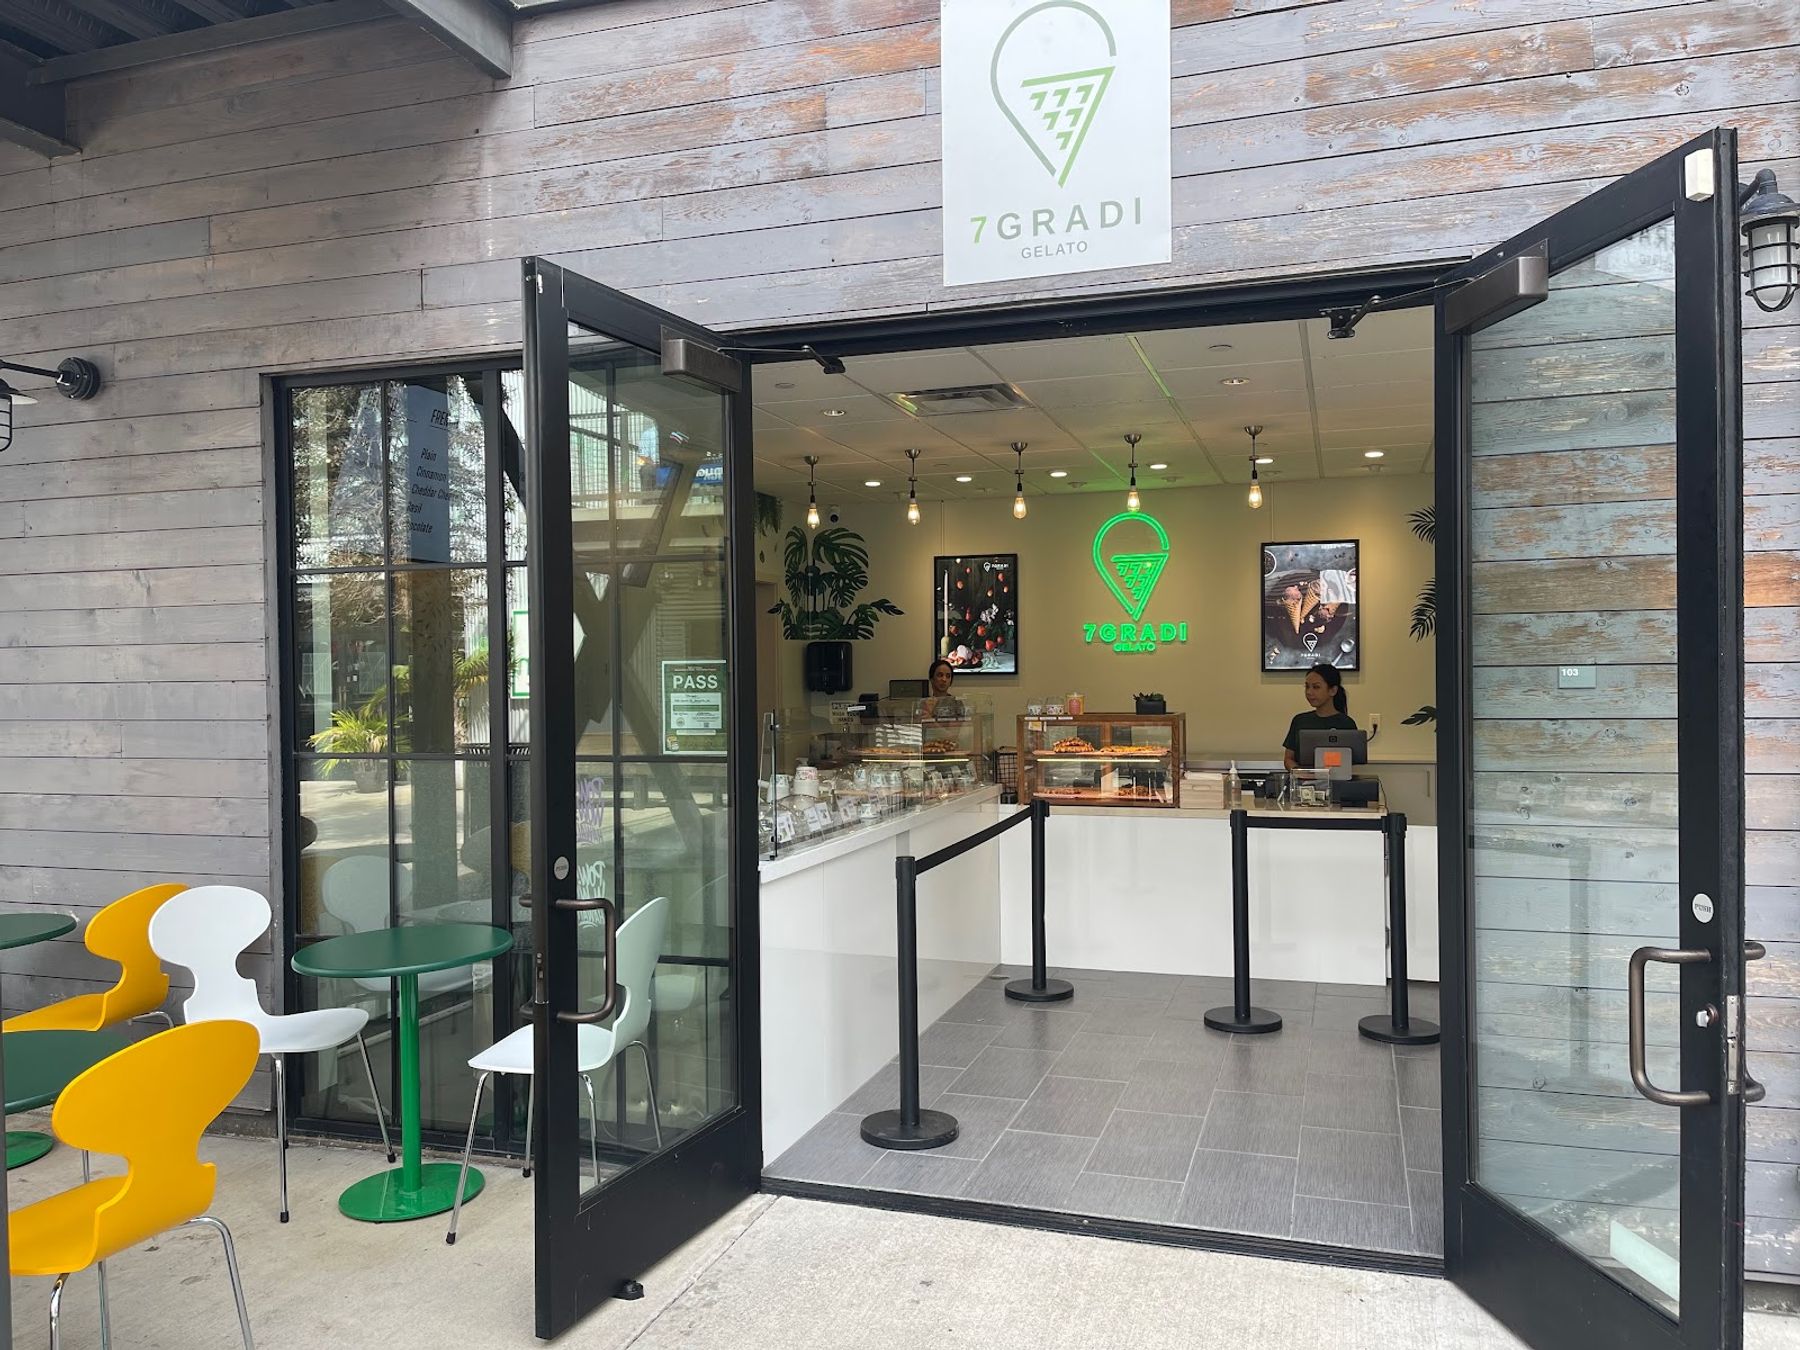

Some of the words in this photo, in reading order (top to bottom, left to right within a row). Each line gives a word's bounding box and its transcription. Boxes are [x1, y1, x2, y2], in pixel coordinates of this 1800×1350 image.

[970, 197, 1141, 244] 7GRADI
[1021, 240, 1088, 259] GELATO
[421, 447, 437, 461] Plain
[1083, 622, 1187, 642] 7GRADI
[1112, 642, 1156, 652] GELATO
[1561, 668, 1579, 677] 103
[672, 674, 718, 689] PASS
